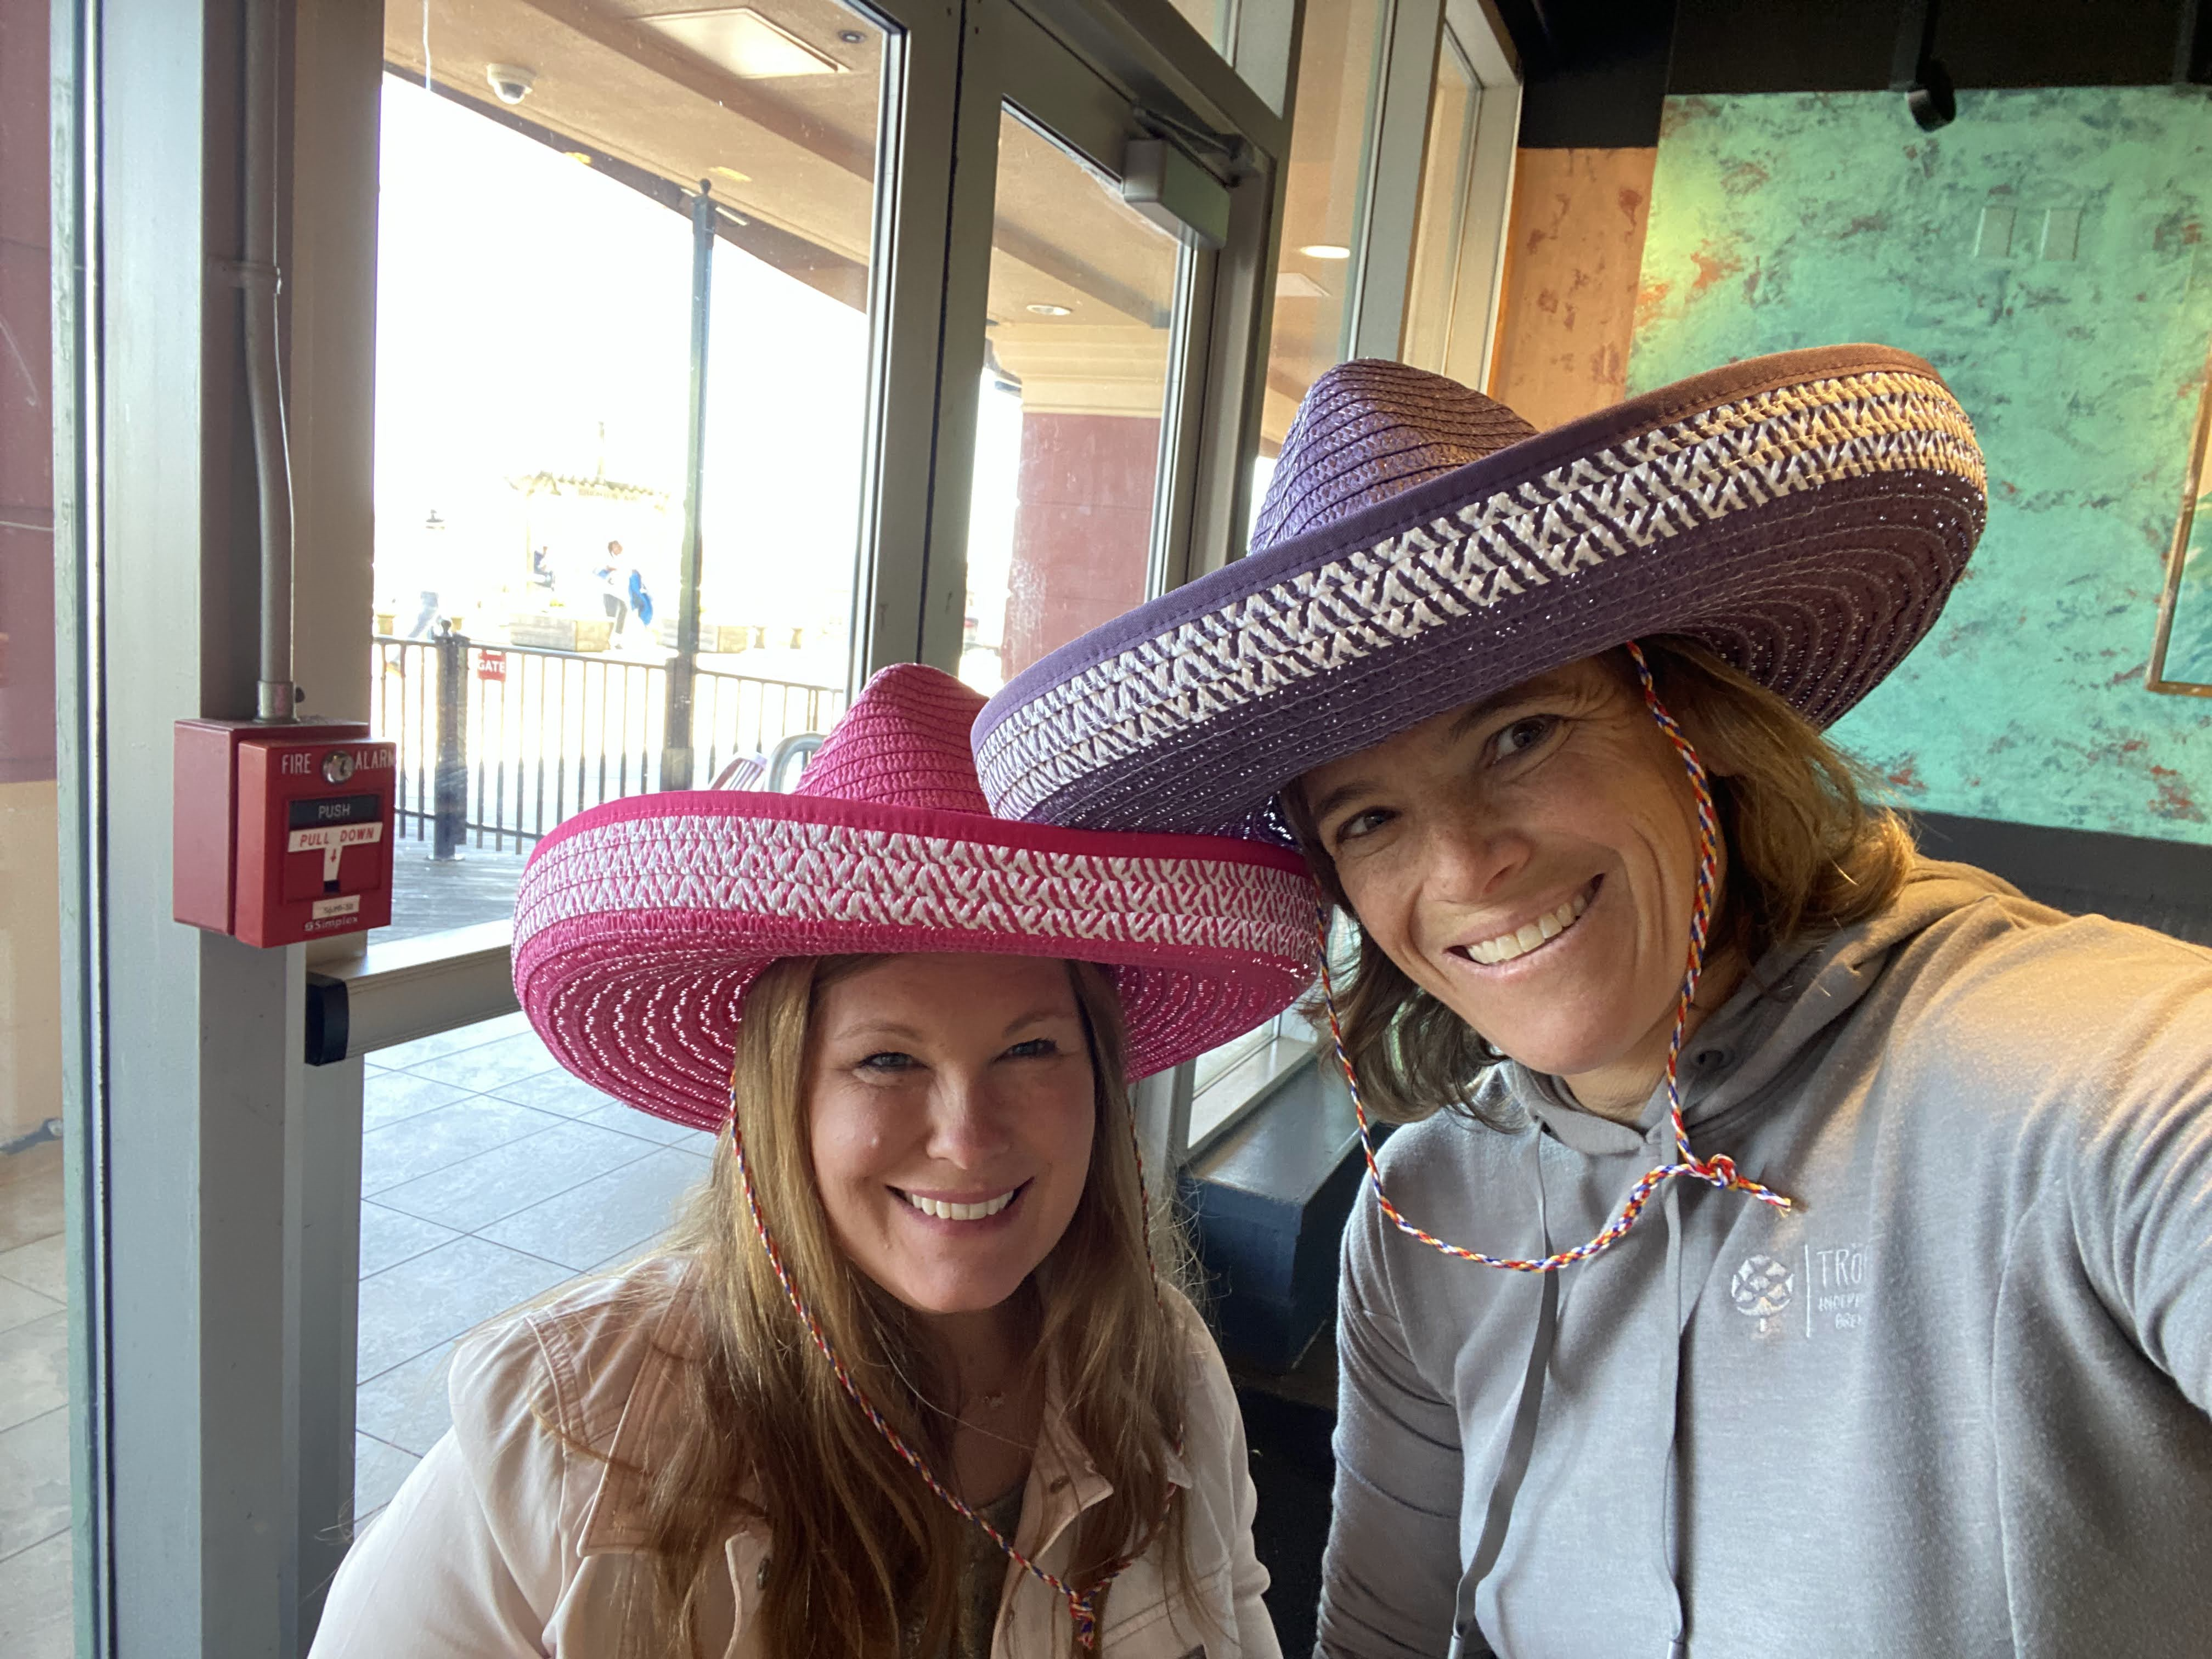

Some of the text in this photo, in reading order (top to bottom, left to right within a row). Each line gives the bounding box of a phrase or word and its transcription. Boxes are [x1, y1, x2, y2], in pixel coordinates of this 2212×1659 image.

[478, 660, 505, 673] GATE
[281, 753, 312, 775] FIRE
[318, 804, 351, 819] PUSH
[300, 827, 374, 848] PULL DOWN
[1816, 1243, 1867, 1288] TRÖ
